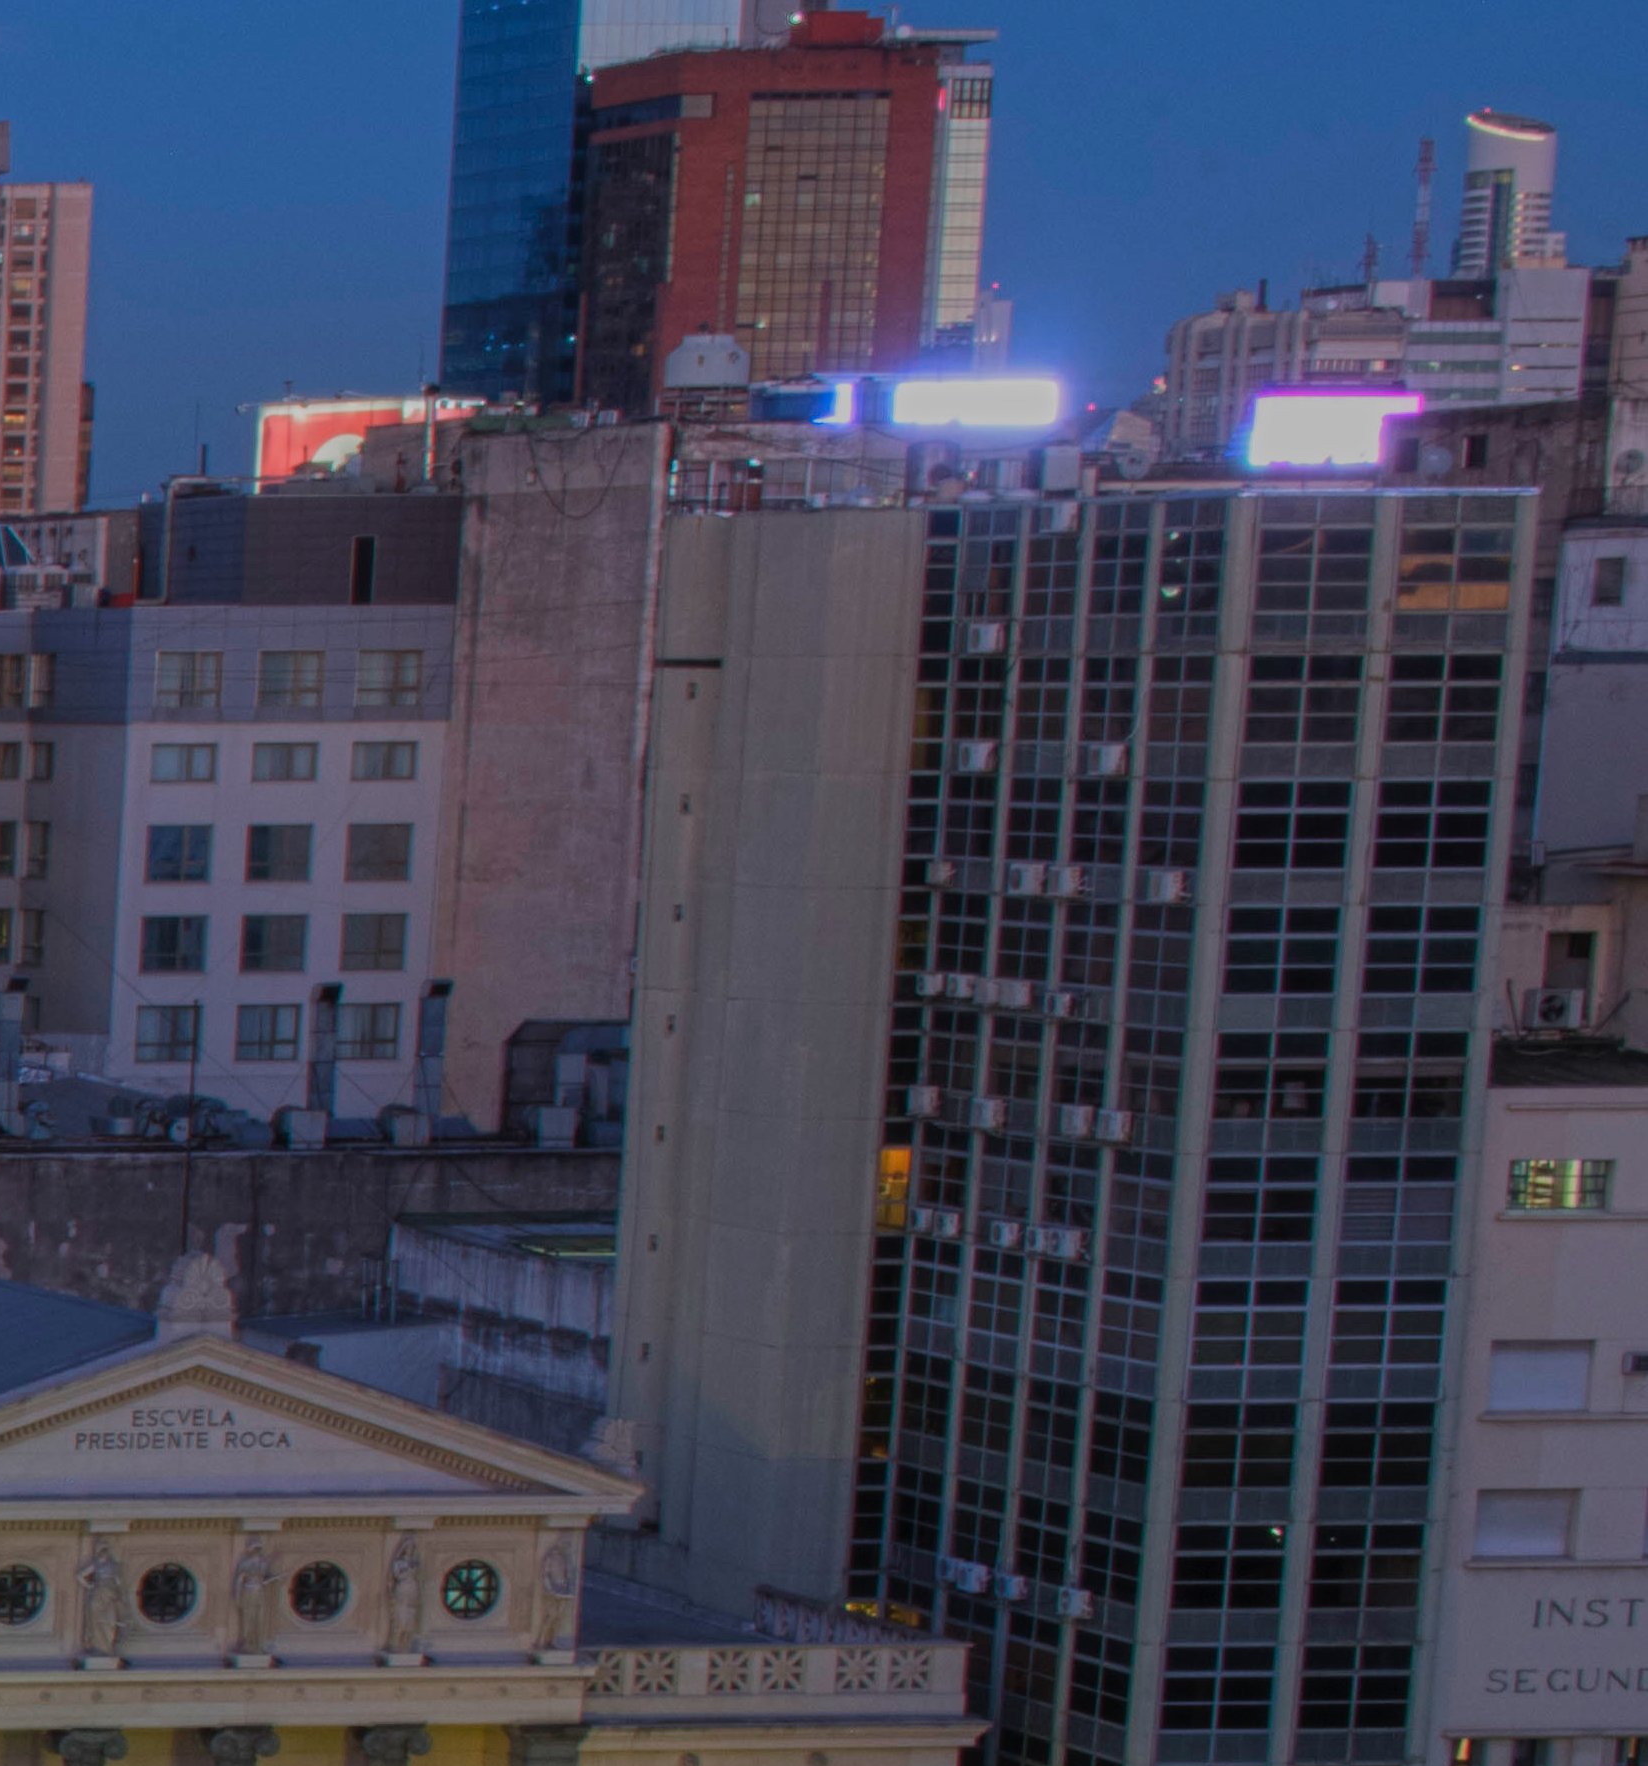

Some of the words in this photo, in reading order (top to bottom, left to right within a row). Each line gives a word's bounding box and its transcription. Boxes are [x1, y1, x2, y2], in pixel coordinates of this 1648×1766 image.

[131, 1408, 235, 1428] ESCVELA
[74, 1431, 209, 1450] PRESIDENTE
[224, 1430, 291, 1449] ROCA
